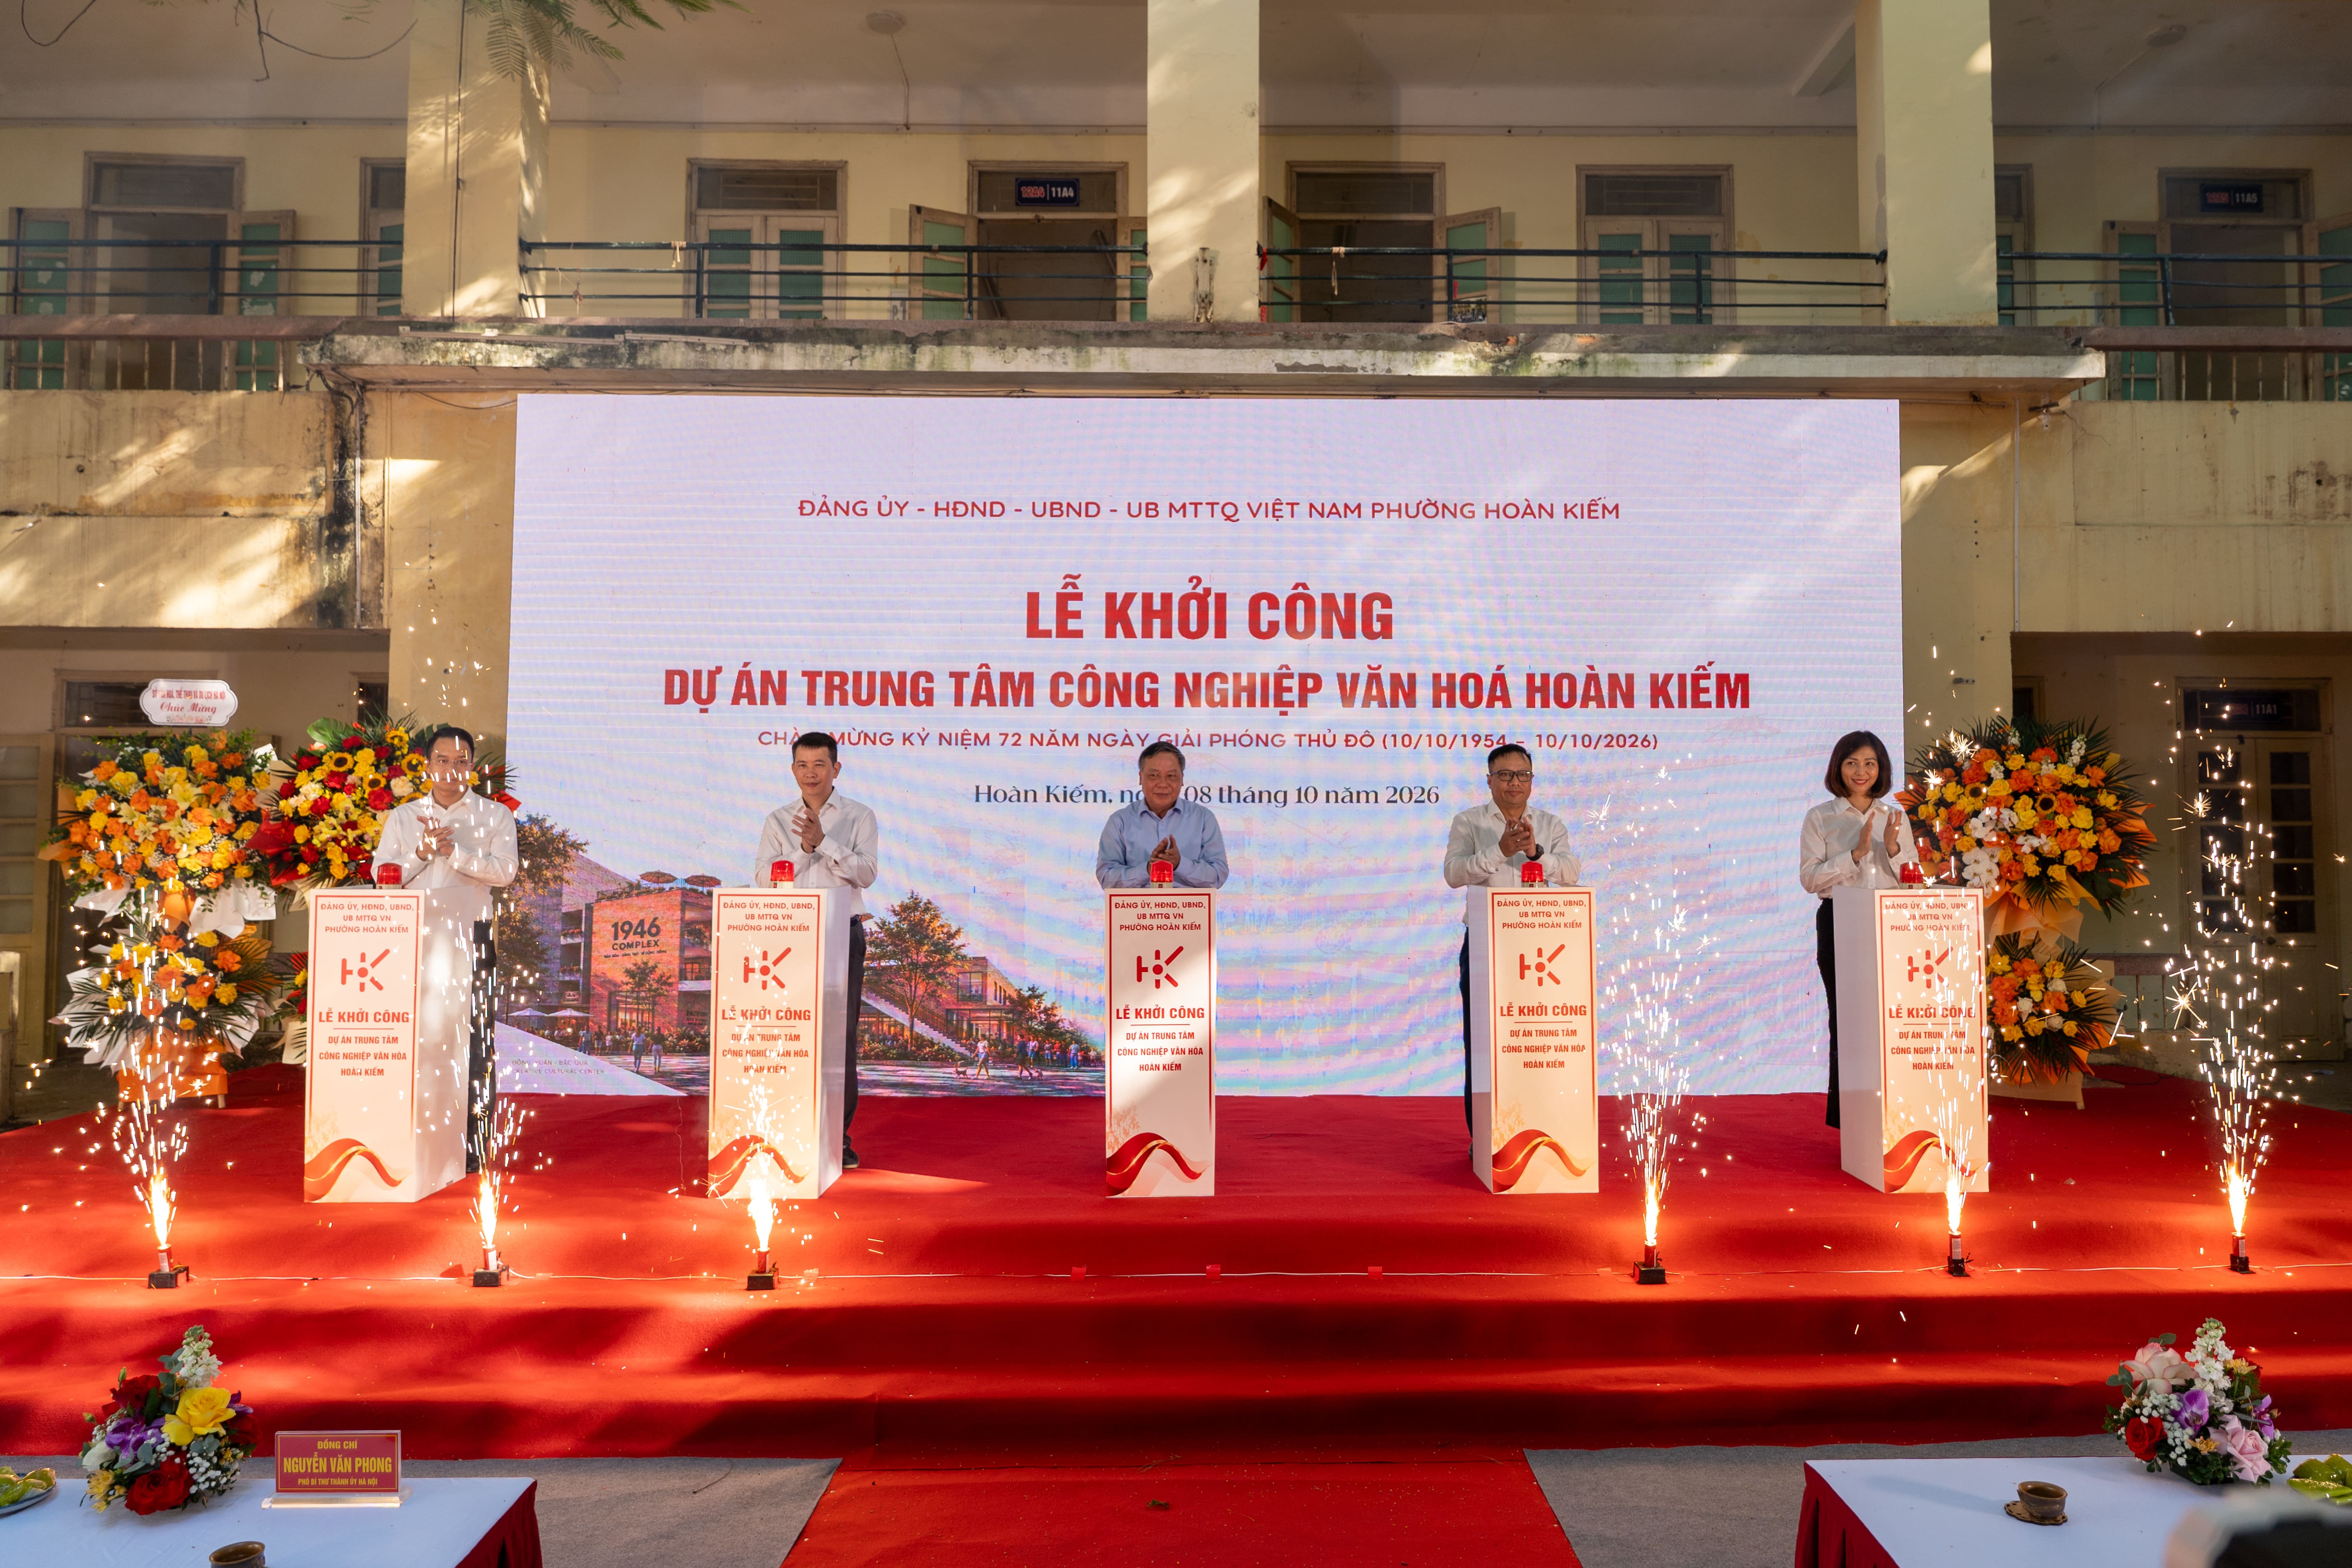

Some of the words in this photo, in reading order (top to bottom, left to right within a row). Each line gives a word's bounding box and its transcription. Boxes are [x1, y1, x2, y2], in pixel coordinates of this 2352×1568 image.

[1051, 187, 1074, 198] 11A4
[798, 494, 868, 517] ĐẢNG
[876, 494, 909, 517] ỦY
[934, 500, 1006, 518] HĐND
[1031, 501, 1101, 518] UBND
[1127, 501, 1160, 519] UB
[1168, 501, 1240, 523] MTTQ
[1246, 498, 1300, 522] VIỆT
[1308, 502, 1362, 519] NAM
[1371, 498, 1476, 519] PHƯỜNG
[1484, 498, 1554, 519] HOÀN
[1563, 497, 1620, 520] KIẾM
[1026, 573, 1084, 639] LỄ
[1104, 575, 1227, 640] KHỞI
[1248, 582, 1394, 641] CÔNG
[664, 665, 723, 714] DỰ
[730, 662, 787, 706] ÁN
[801, 670, 935, 707] TRUNG
[949, 663, 1035, 707] TÂM
[1049, 664, 1159, 709] CÔNG
[1174, 664, 1323, 716] NGHIỆP
[1337, 664, 1417, 709] VĂN
[1431, 664, 1512, 709] HOÁ
[1525, 664, 1635, 710] HOÀN
[1649, 661, 1750, 709] KIẾM
[2256, 704, 2278, 715] 11A1
[829, 727, 895, 747] MỪNG
[901, 726, 930, 747] KỶ
[938, 728, 991, 750] NIỆM
[997, 732, 1022, 747] 72
[1029, 729, 1079, 748] NĂM
[1087, 728, 1149, 748] NGÀY
[1157, 728, 1201, 747] GIẢI
[1209, 728, 1286, 748] PHÓNG
[1293, 728, 1338, 748] THỦ
[1343, 730, 1376, 748] ĐÔ
[1380, 733, 1508, 750] (10/10/1954
[1536, 733, 1658, 750] 10/10/2026)
[975, 785, 1038, 803] Hoàn
[1184, 785, 1212, 804] 08
[1219, 785, 1288, 807] tháng
[1295, 786, 1318, 804] 10
[1325, 787, 1379, 804] năm
[1386, 786, 1439, 804] 2026
[612, 917, 661, 941] 1946
[727, 923, 763, 931] PHƯỜNG
[764, 923, 789, 932] HOÀN
[790, 923, 810, 932] KIẾM
[1119, 923, 1154, 931] PHƯỜNG
[1156, 922, 1180, 931] HOÀN
[1182, 922, 1201, 931] KIẾM
[1502, 921, 1536, 929] PHƯỜNG
[1538, 921, 1562, 929] HOÀN
[1563, 920, 1582, 928] KIẾM
[612, 939, 660, 950] COMPLEX
[318, 1007, 333, 1022] LỄ
[338, 1008, 369, 1023] KHỞI
[373, 1010, 410, 1023] CÔNG
[1116, 1004, 1130, 1020] LỄ
[1135, 1004, 1165, 1019] KHỞI
[1170, 1005, 1204, 1019] CÔNG
[1500, 1002, 1514, 1017] LỄ
[1518, 1002, 1548, 1017] KHỞI
[1552, 1003, 1587, 1016] CÔNG
[1126, 1032, 1137, 1041] DỰ
[1178, 1030, 1195, 1040] TÂM
[1510, 1029, 1521, 1038] DỰ
[1522, 1029, 1533, 1037] ÁN
[1535, 1029, 1559, 1037] TRUNG
[1561, 1028, 1577, 1037] TÂM
[1117, 1048, 1138, 1056] CÔNG
[1140, 1047, 1168, 1056] NGHIỆP
[1170, 1047, 1186, 1056] VĂN
[1188, 1046, 1203, 1056] HÓA
[1502, 1044, 1523, 1053] CÔNG
[1524, 1044, 1552, 1054] NGHIỆP
[1554, 1044, 1569, 1053] VĂN
[319, 1051, 341, 1060] CÔNG
[342, 1051, 371, 1061] NGHIỆP
[373, 1051, 389, 1060] VĂN
[391, 1051, 407, 1060] HÓA
[1162, 1062, 1182, 1072] KIẾM
[1523, 1060, 1544, 1069] HOÀN
[1546, 1059, 1565, 1069] KIẾM
[1912, 1062, 1933, 1070] HOÀN
[343, 1439, 358, 1449] CHÍ
[283, 1452, 327, 1473] NGUYỄN
[329, 1454, 352, 1473] VĂN
[354, 1457, 392, 1473] PHONG
[310, 1477, 317, 1486] BÍ
